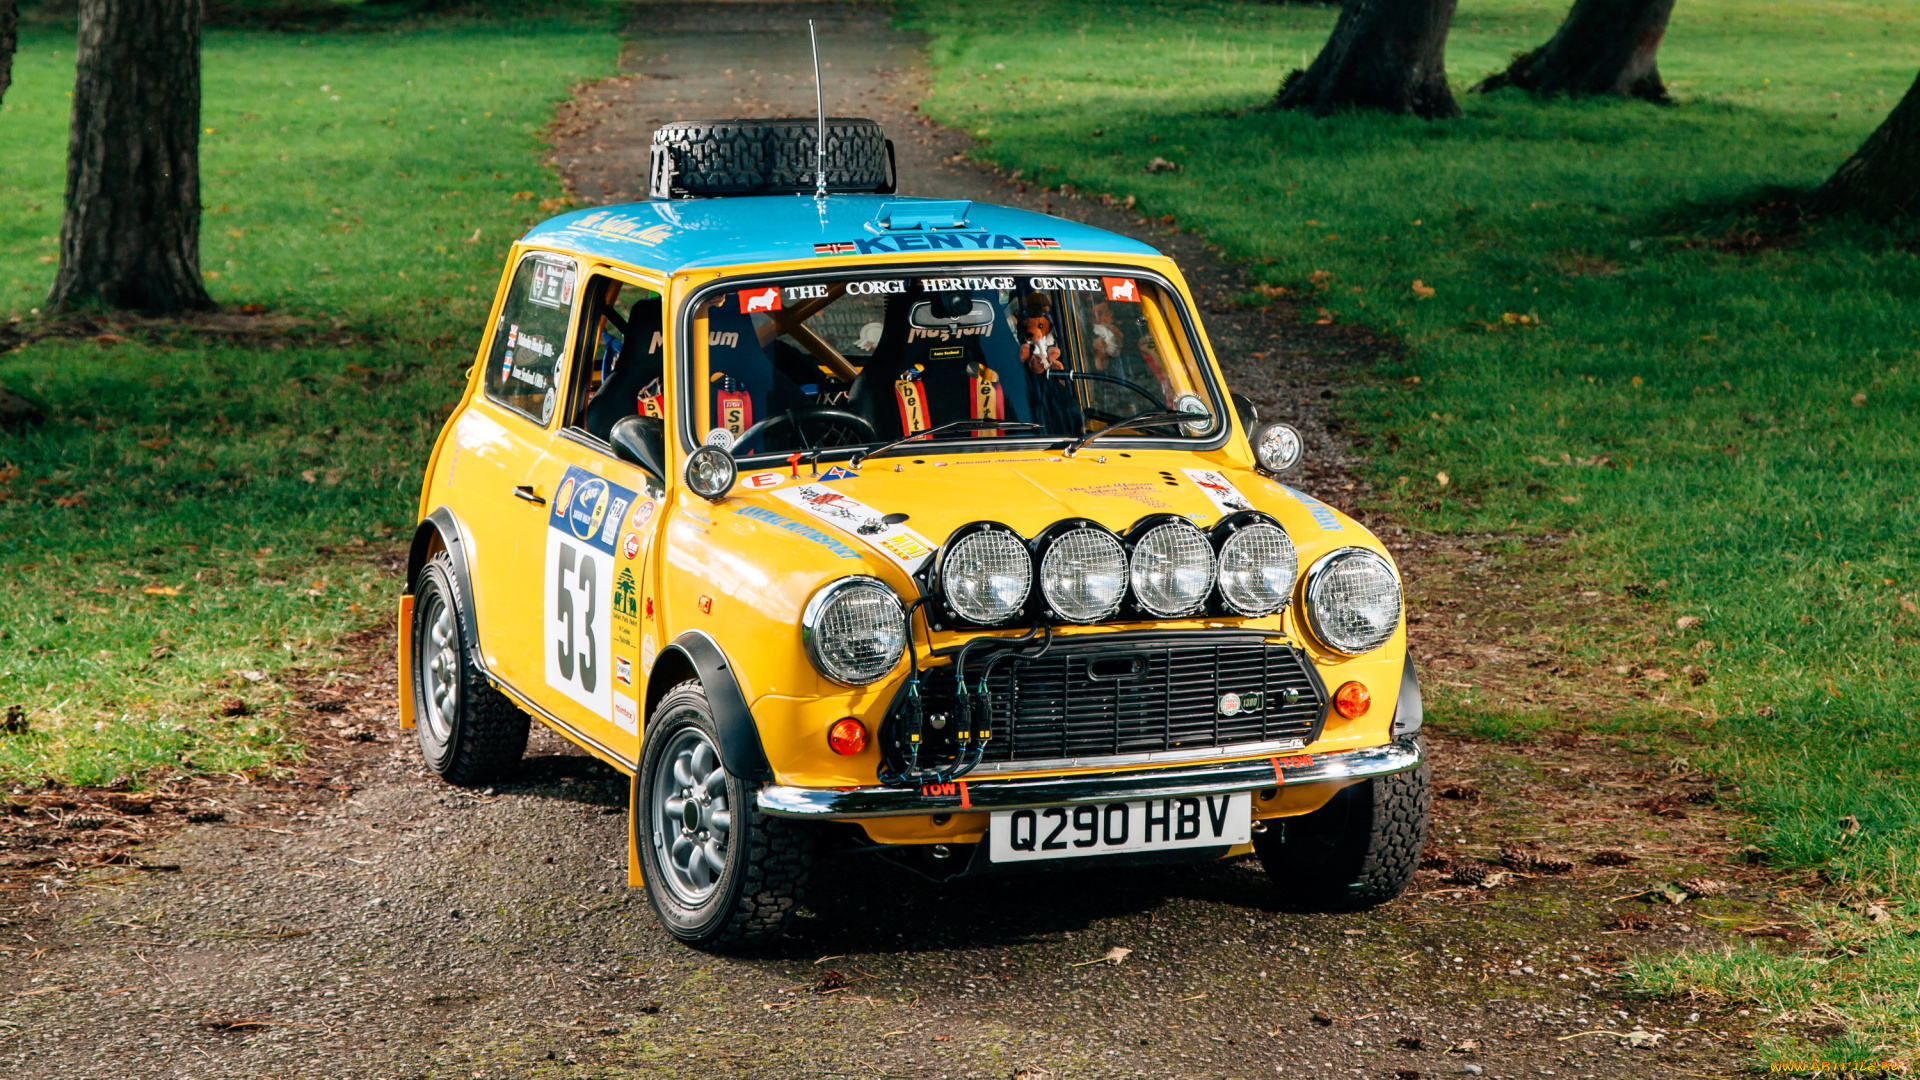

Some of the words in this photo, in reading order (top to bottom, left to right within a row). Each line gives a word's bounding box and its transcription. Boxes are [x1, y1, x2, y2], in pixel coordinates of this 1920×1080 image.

[854, 234, 1027, 255] KENYA
[784, 284, 829, 300] THE
[845, 280, 906, 296] CORGI
[921, 277, 1016, 293] HERITAGE
[1029, 277, 1102, 292] CENTRE
[751, 474, 776, 487] E
[887, 534, 929, 558] MINI
[558, 542, 597, 694] 53
[615, 704, 633, 719] mintex
[1281, 755, 1314, 770] TOW
[921, 784, 956, 796] TOW
[1010, 803, 1129, 852] Q290
[1144, 794, 1232, 843] HBV
